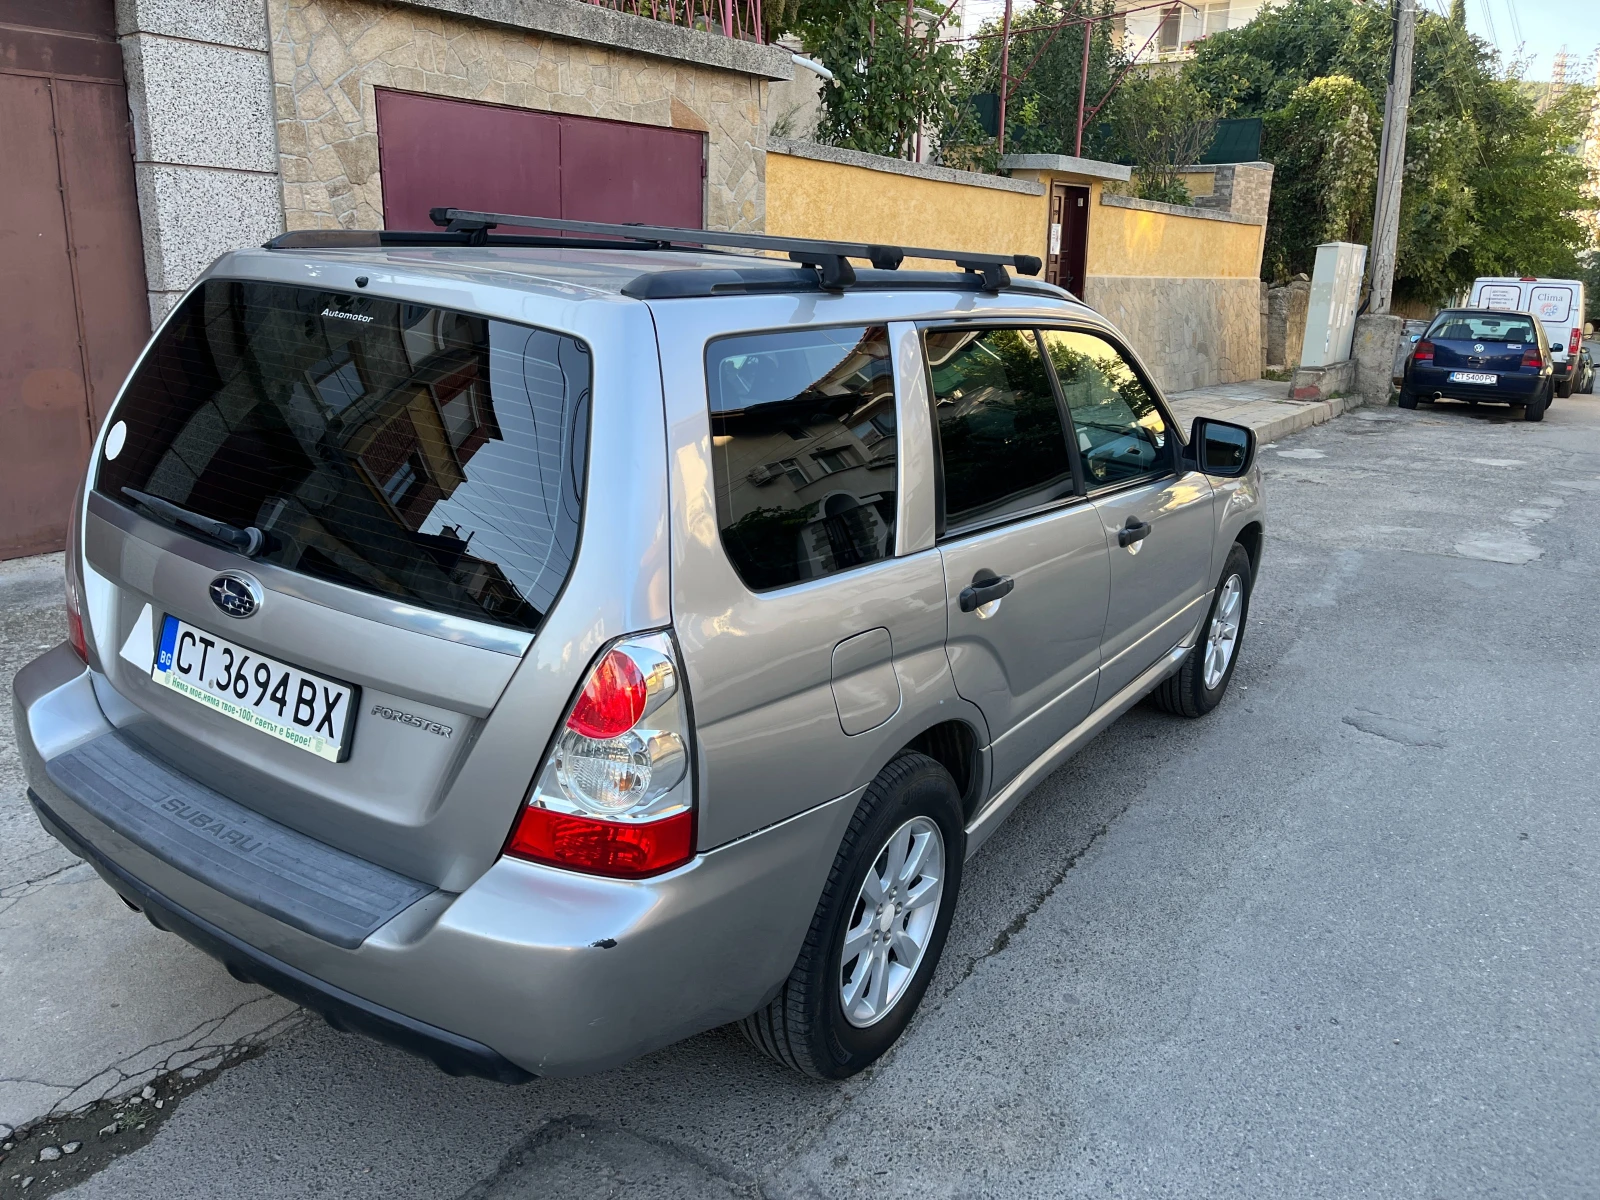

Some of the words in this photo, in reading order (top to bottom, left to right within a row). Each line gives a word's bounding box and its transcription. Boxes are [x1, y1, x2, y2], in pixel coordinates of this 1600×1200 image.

[1537, 293, 1564, 302] Clima
[320, 308, 374, 323] Automotor
[1454, 372, 1465, 380] CT
[1465, 374, 1484, 382] 5400
[1484, 375, 1496, 383] PC
[160, 650, 172, 666] BG
[176, 631, 215, 682] CT
[215, 647, 291, 718] 3694
[292, 677, 343, 739] BX
[172, 676, 189, 693] Няма
[254, 717, 278, 733] светът
[279, 728, 284, 736] е
[285, 727, 312, 747] Берое!
[371, 704, 453, 739] FORESTER
[160, 798, 263, 853] SUBARU
